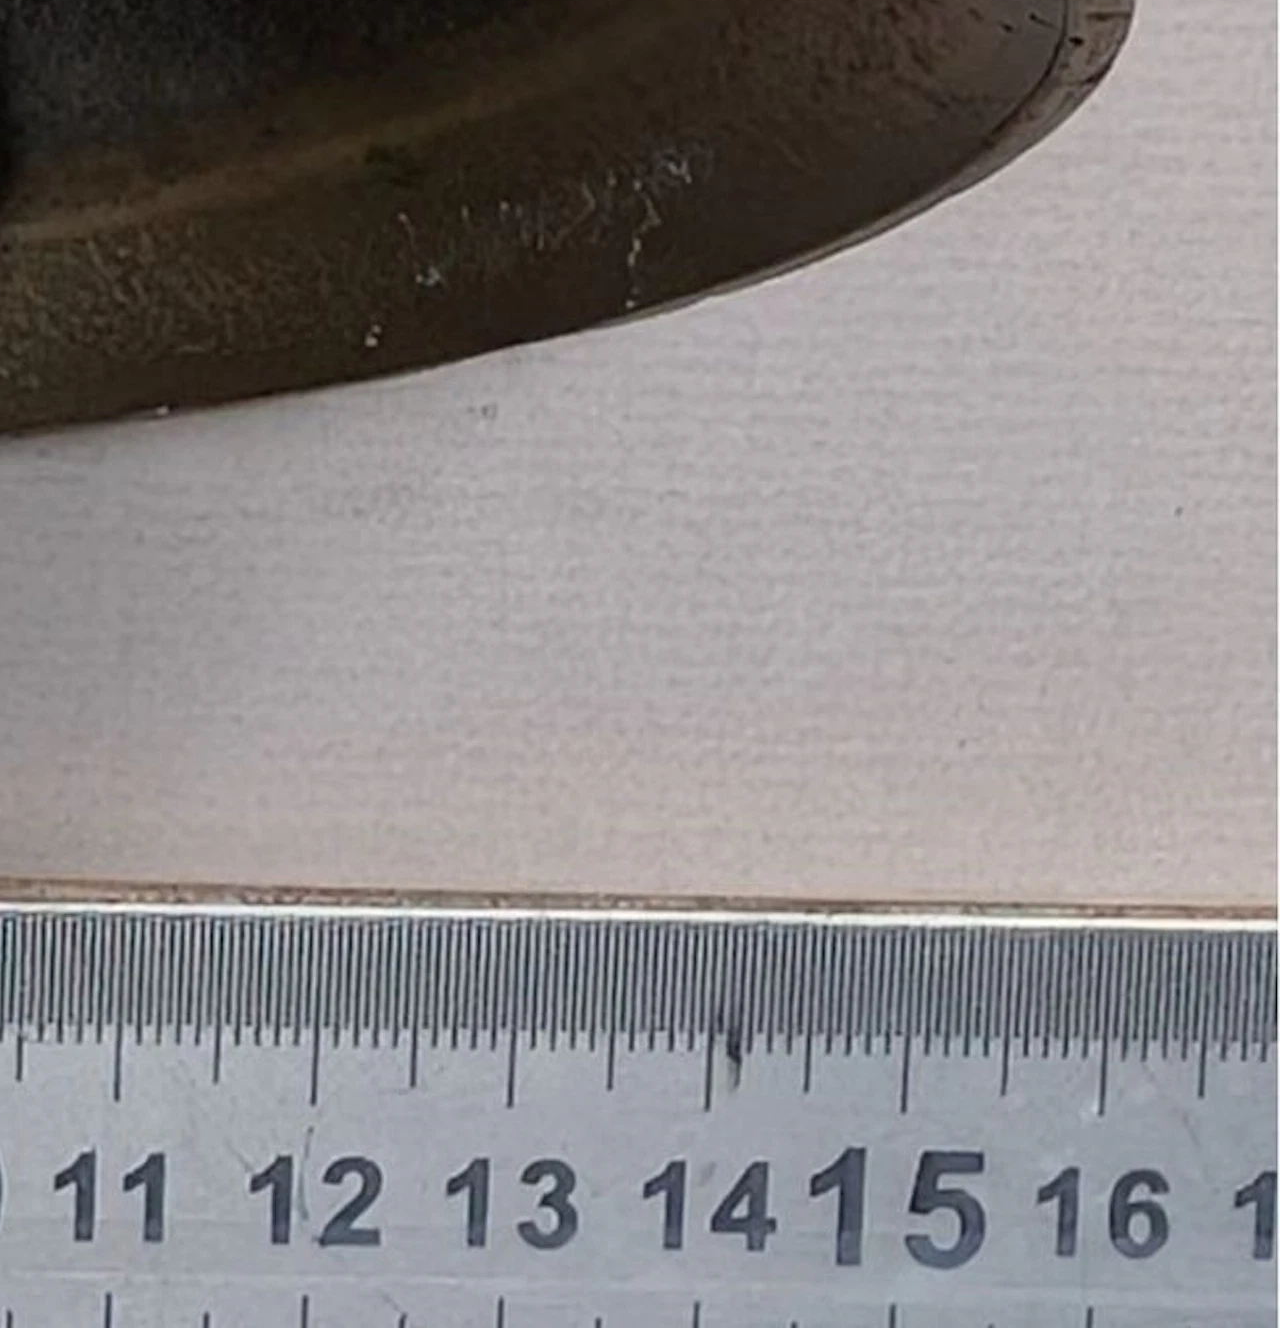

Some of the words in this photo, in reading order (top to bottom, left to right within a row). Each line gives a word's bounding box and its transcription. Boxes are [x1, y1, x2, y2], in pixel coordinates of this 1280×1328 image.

[53, 1149, 166, 1243] 11
[249, 1154, 383, 1249] 12
[445, 1157, 578, 1250] 13
[642, 1160, 778, 1252] 14
[809, 1146, 986, 1270] 15
[1036, 1166, 1170, 1260] 16
